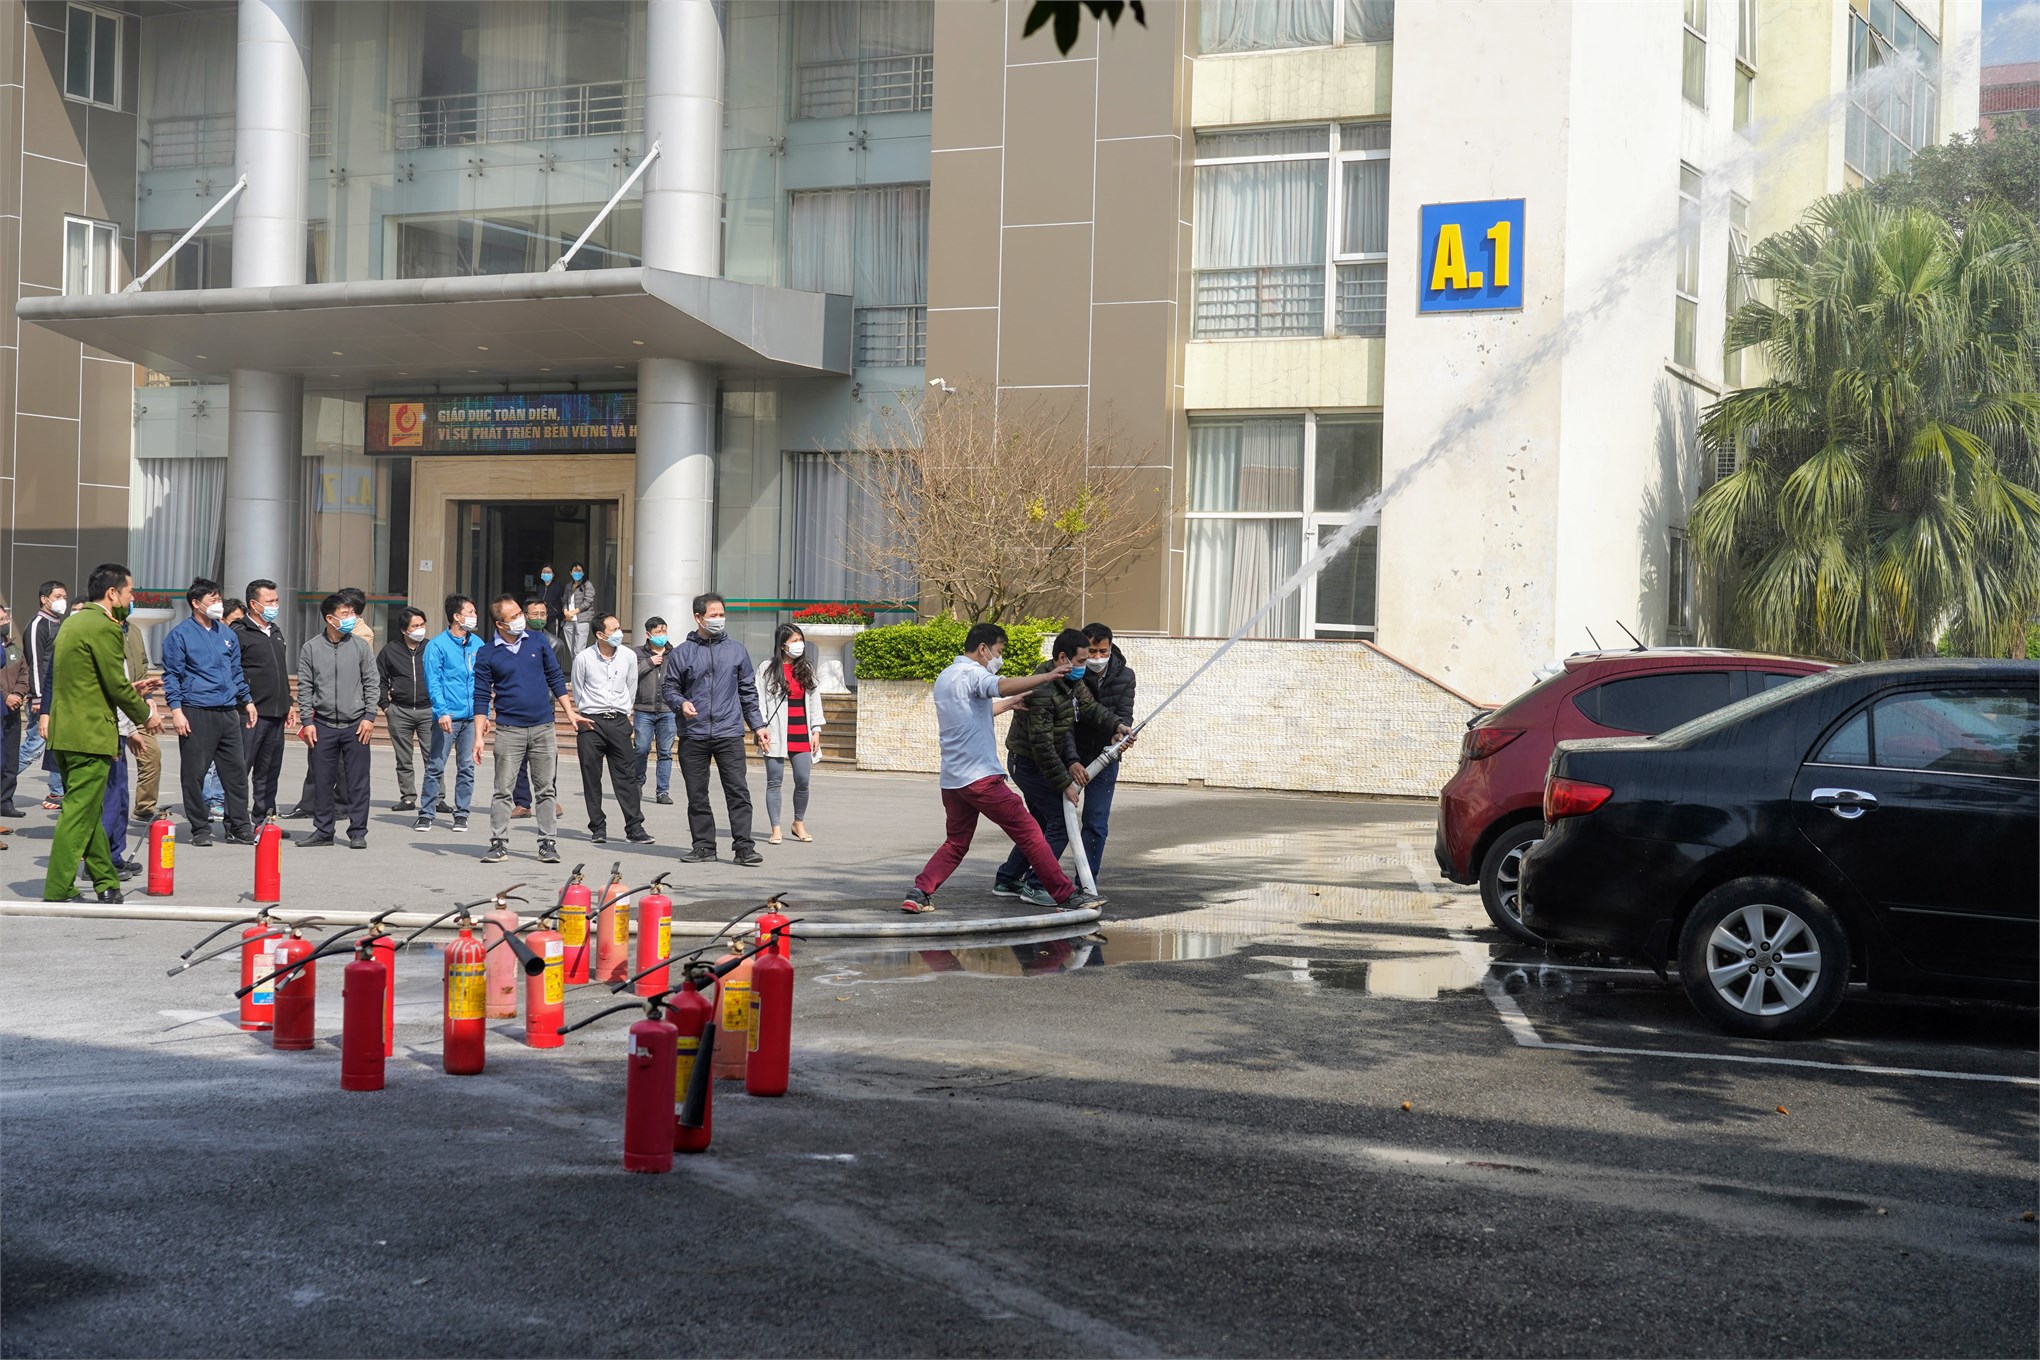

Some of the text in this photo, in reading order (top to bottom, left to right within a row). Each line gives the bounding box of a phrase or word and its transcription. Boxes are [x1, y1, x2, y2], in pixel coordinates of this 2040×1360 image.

[1430, 221, 1511, 290] A.1
[437, 404, 561, 424] GIÁO DỤC TOÀN DIỆN,
[437, 425, 450, 440] VÌ
[453, 427, 470, 443] SỰ
[472, 424, 503, 440] PHÁT
[506, 422, 541, 439] TRIỂN
[543, 423, 569, 438] BỀN
[571, 422, 607, 438] VỮNG
[610, 422, 627, 438] VÀ
